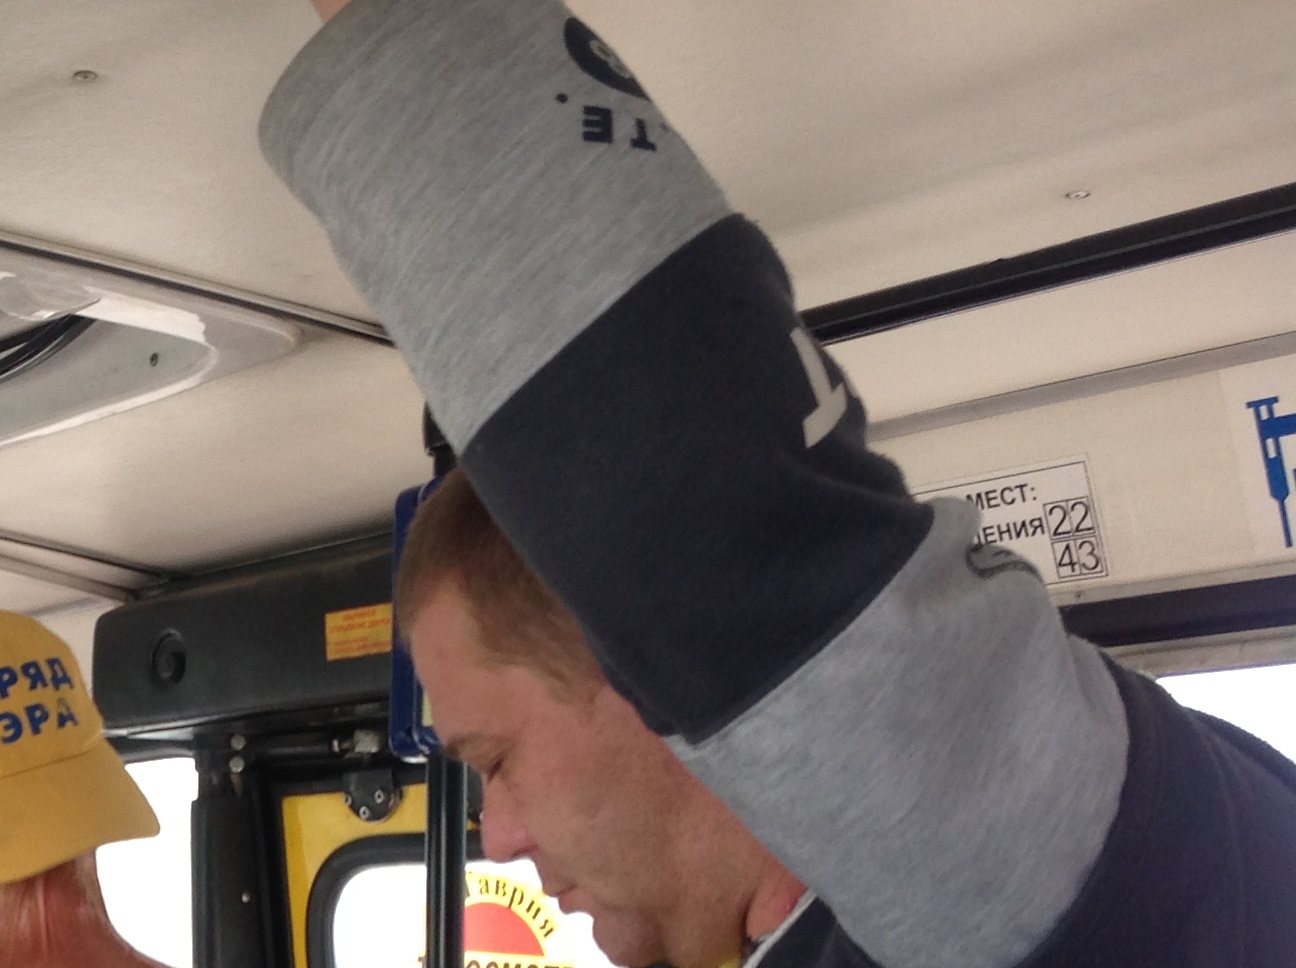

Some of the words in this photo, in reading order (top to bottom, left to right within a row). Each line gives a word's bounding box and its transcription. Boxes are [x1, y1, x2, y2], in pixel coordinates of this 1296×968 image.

[965, 483, 1038, 512] МЕСТ:
[1048, 500, 1096, 537] 22
[1057, 541, 1103, 574] 43
